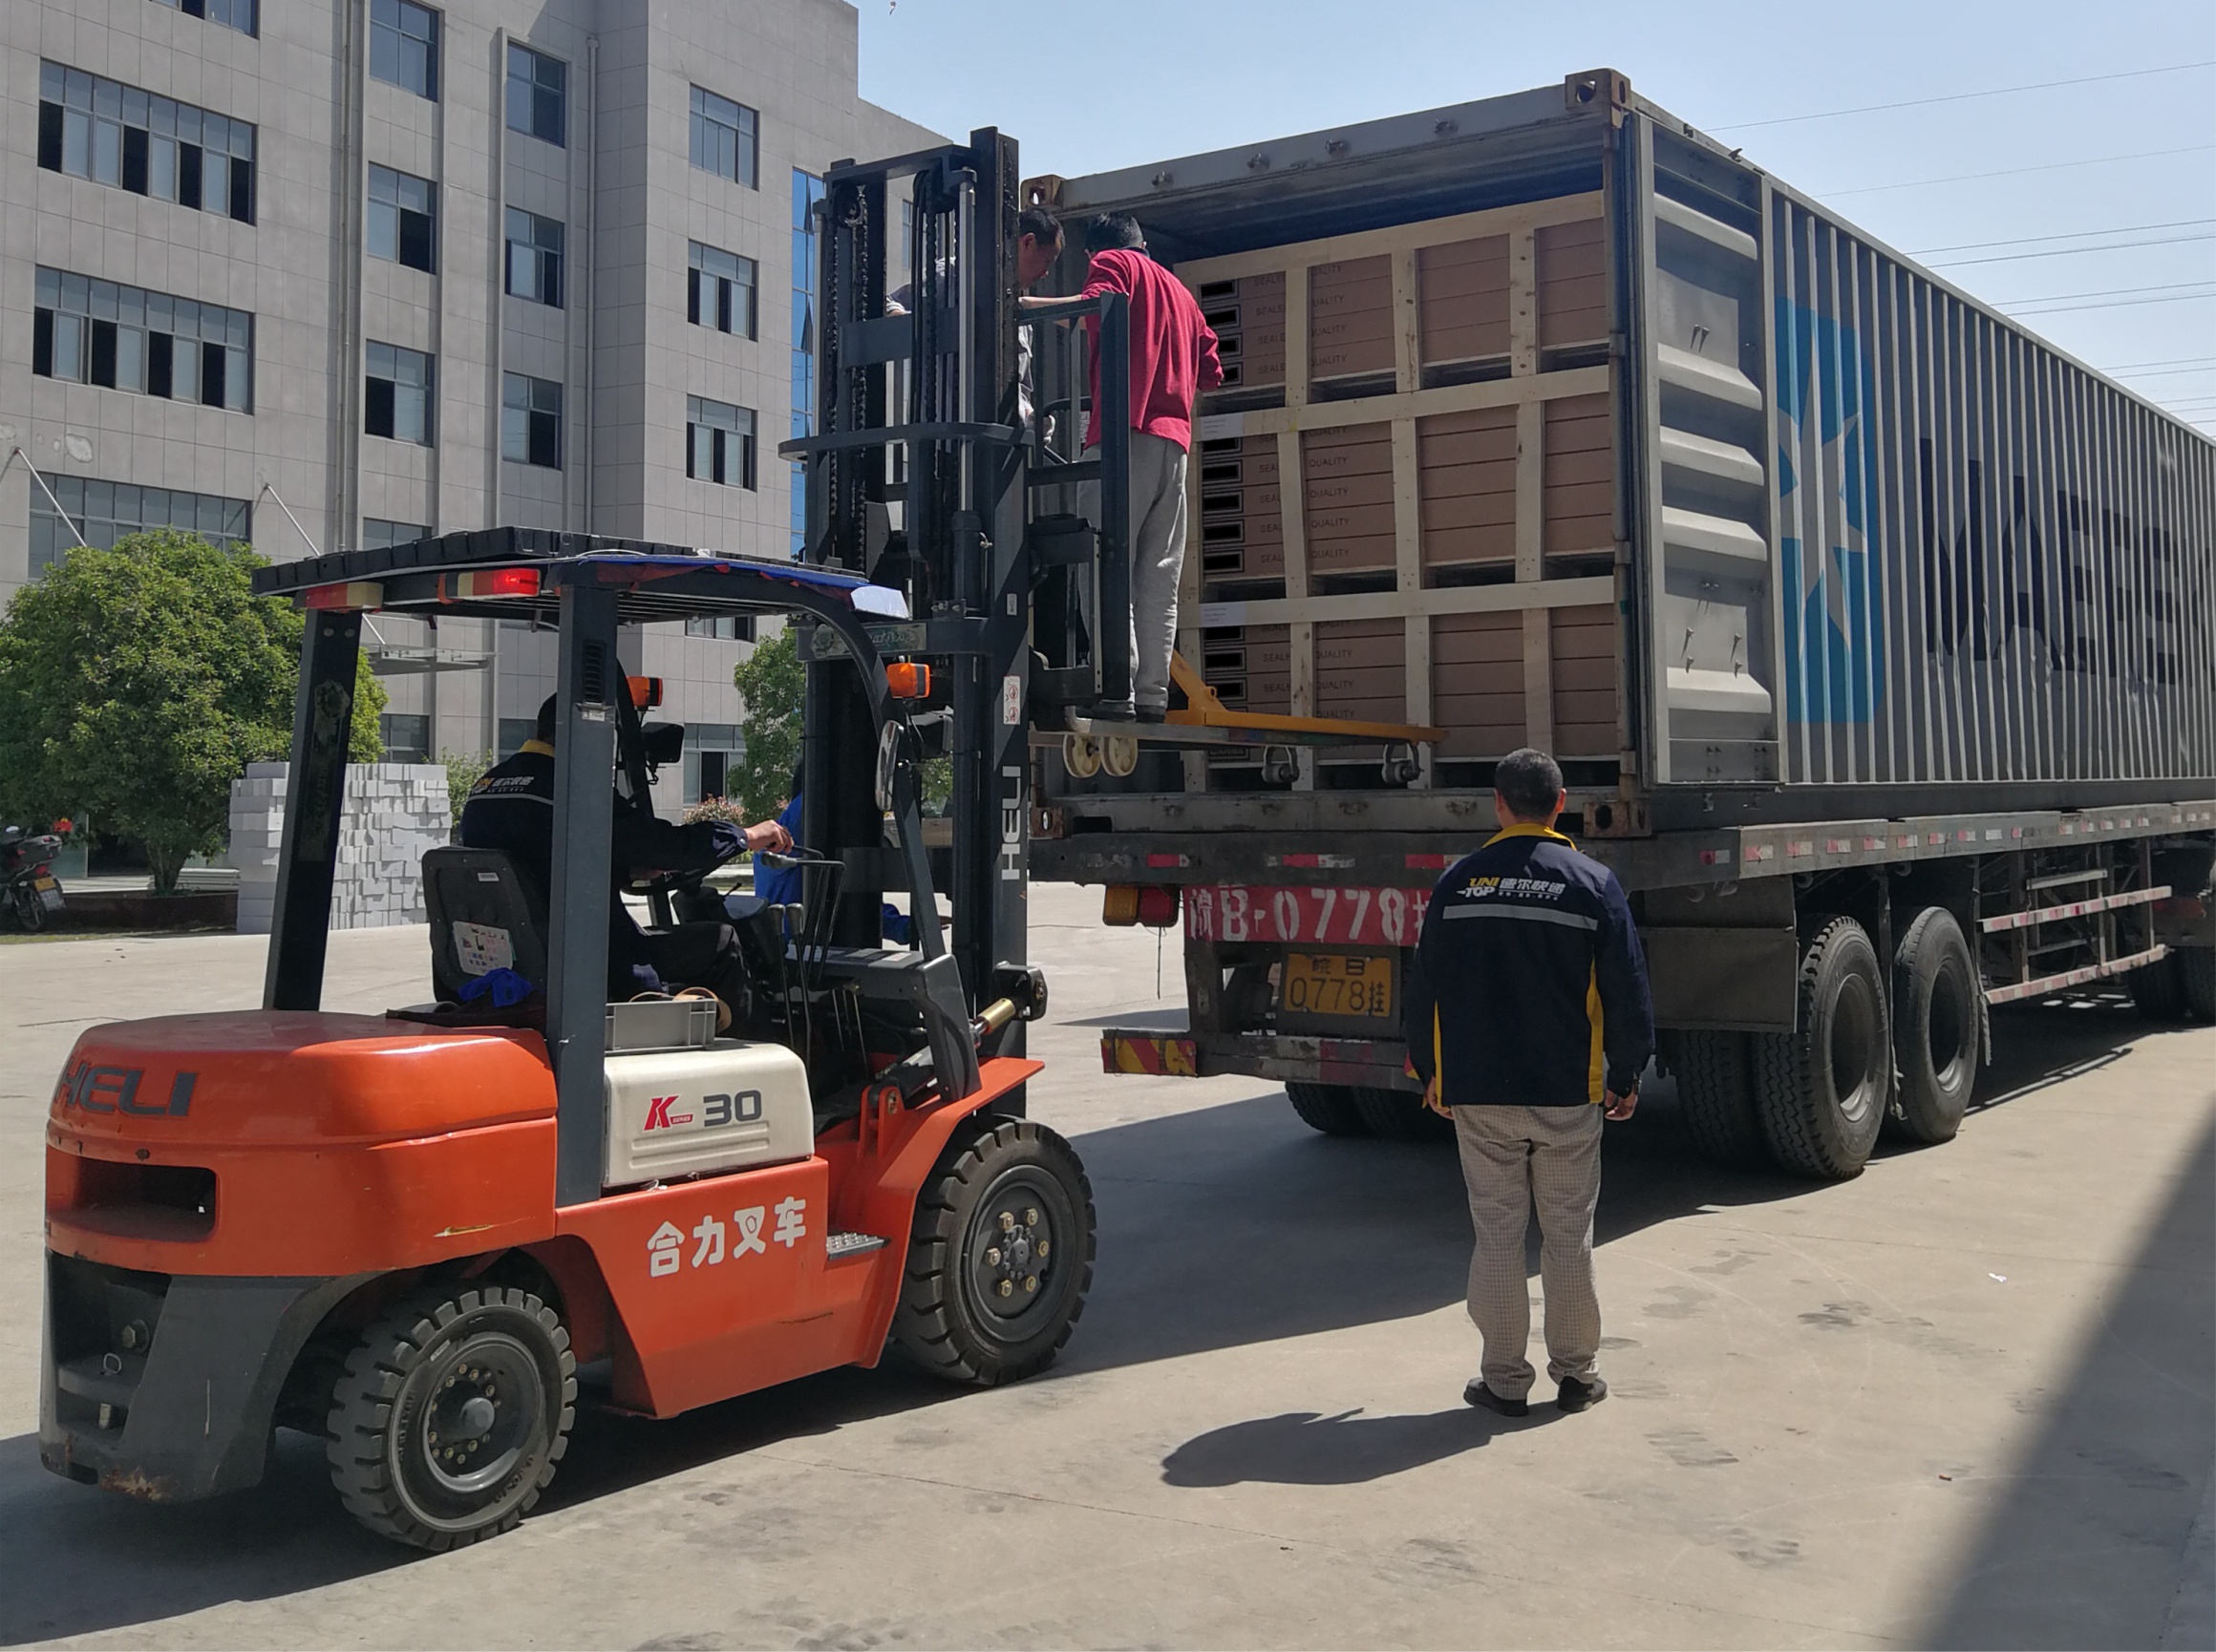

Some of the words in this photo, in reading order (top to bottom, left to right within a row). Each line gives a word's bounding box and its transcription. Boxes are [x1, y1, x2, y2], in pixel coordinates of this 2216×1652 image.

[1311, 294, 1344, 307] UALITY
[1311, 324, 1347, 337] UALITY
[1311, 353, 1348, 367] UALITY
[1310, 456, 1349, 468] QUALITY
[1310, 486, 1350, 498] QUALITY
[1311, 517, 1350, 529] QUALITY
[1311, 548, 1350, 560] QUALITY
[1001, 766, 1021, 880] HELI
[1470, 877, 1501, 887] UNI
[1465, 886, 1496, 898] TOP
[1290, 977, 1385, 1014] 0778挂
[54, 1056, 198, 1117] HELI
[643, 1095, 680, 1132] K
[703, 1089, 762, 1127] 30
[647, 1196, 807, 1278] 合力叉车
